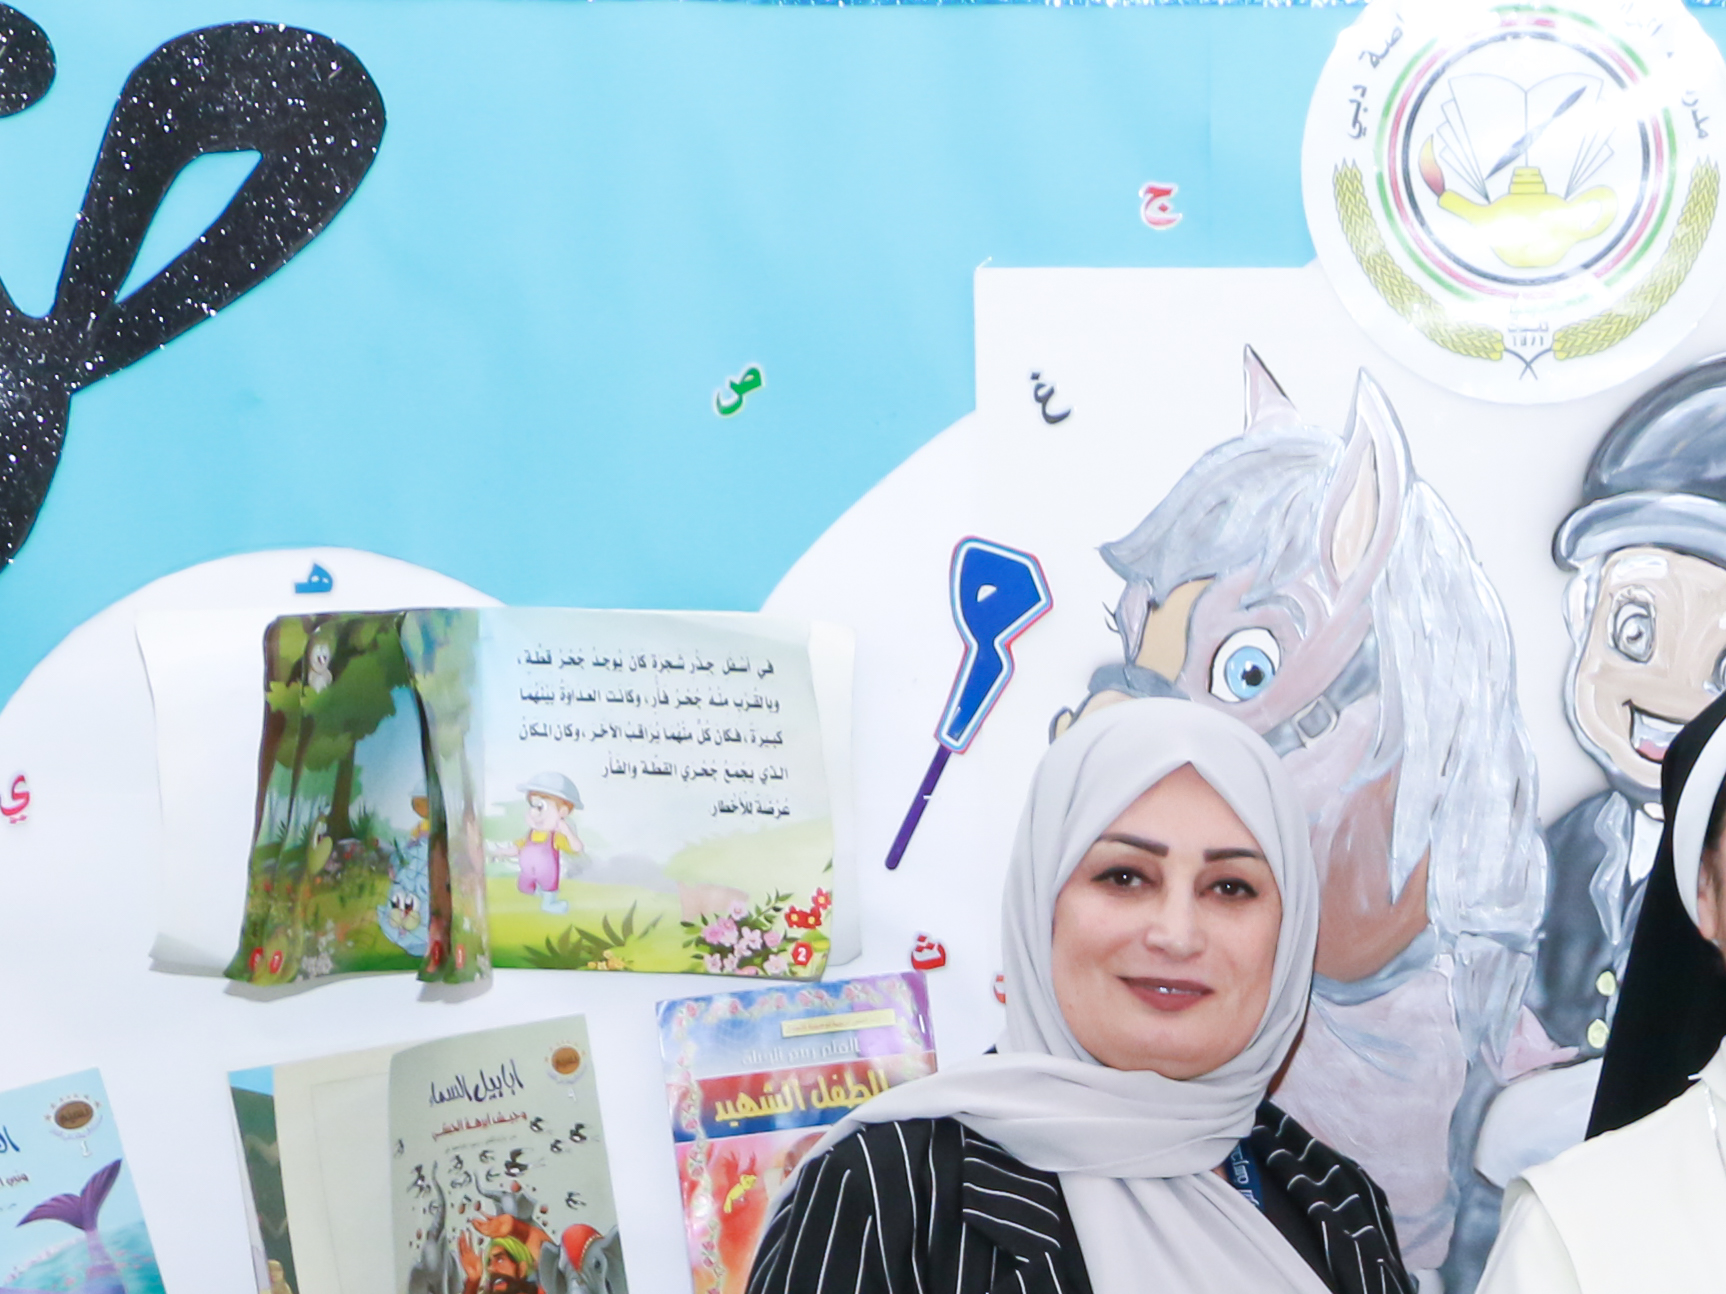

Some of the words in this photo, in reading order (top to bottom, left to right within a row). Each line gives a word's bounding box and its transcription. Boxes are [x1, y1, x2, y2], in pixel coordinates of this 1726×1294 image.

[1142, 184, 1182, 227] ج
[714, 366, 764, 416] ص
[1030, 371, 1072, 425] غ
[715, 1074, 806, 1128] الشهيد
[811, 1069, 891, 1110] الطفل
